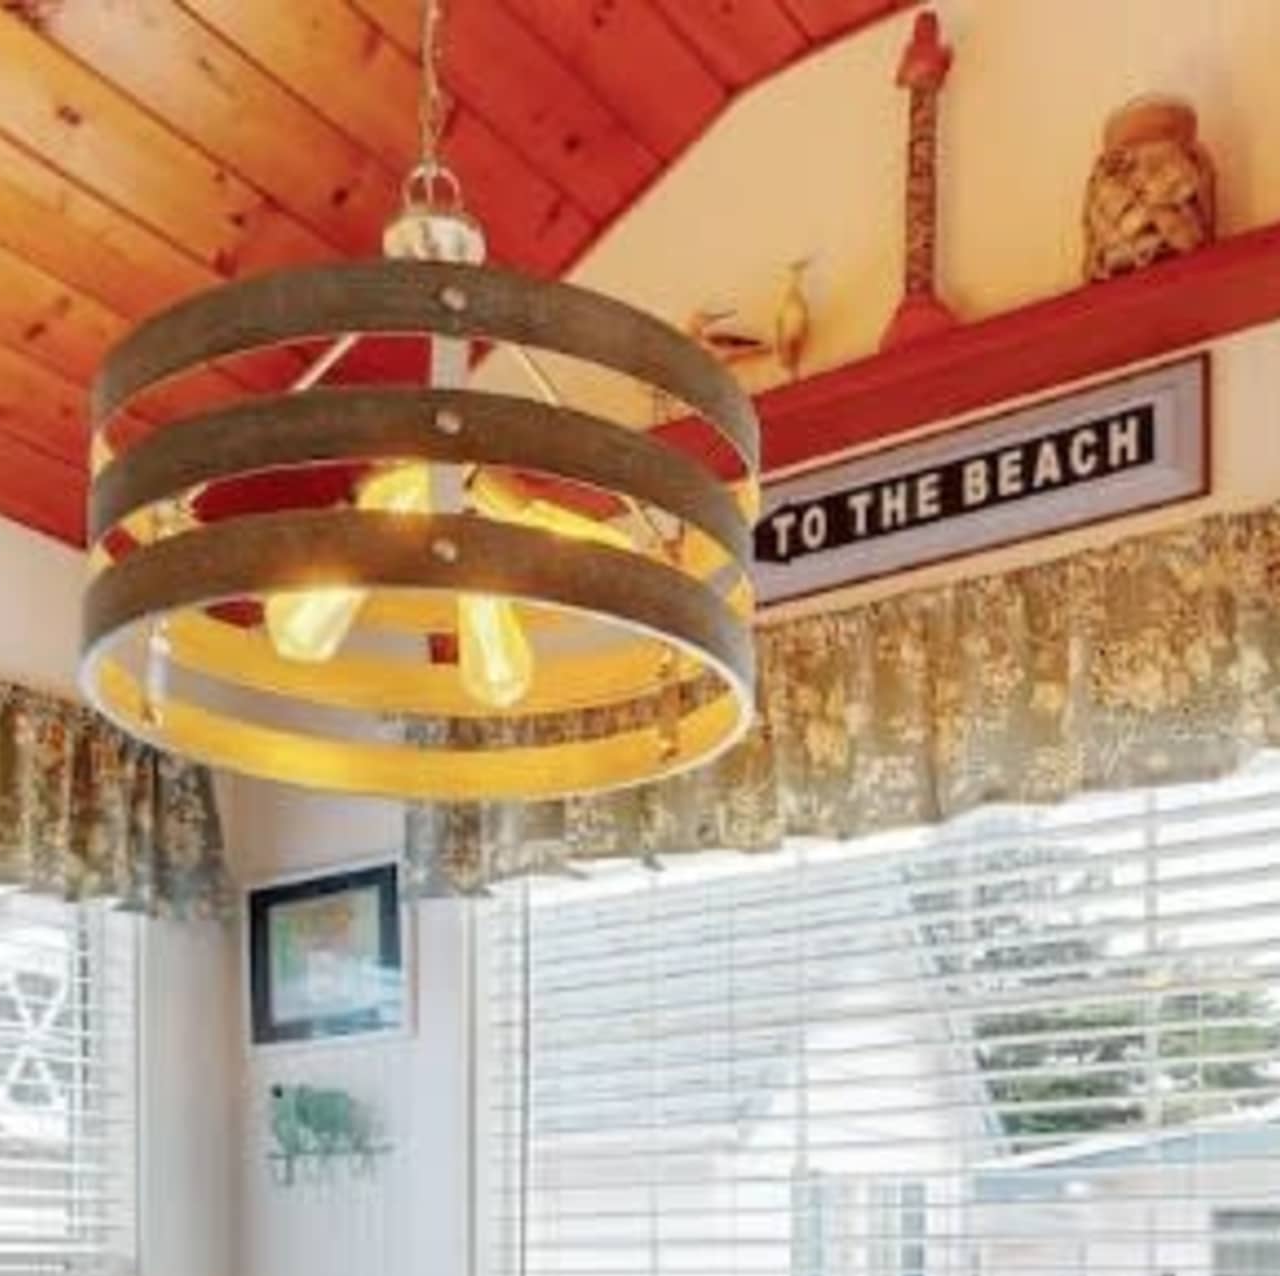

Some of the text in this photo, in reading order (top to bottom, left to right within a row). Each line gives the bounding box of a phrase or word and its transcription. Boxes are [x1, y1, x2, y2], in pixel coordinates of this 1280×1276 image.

[773, 418, 1139, 556] TO THE BEACH
